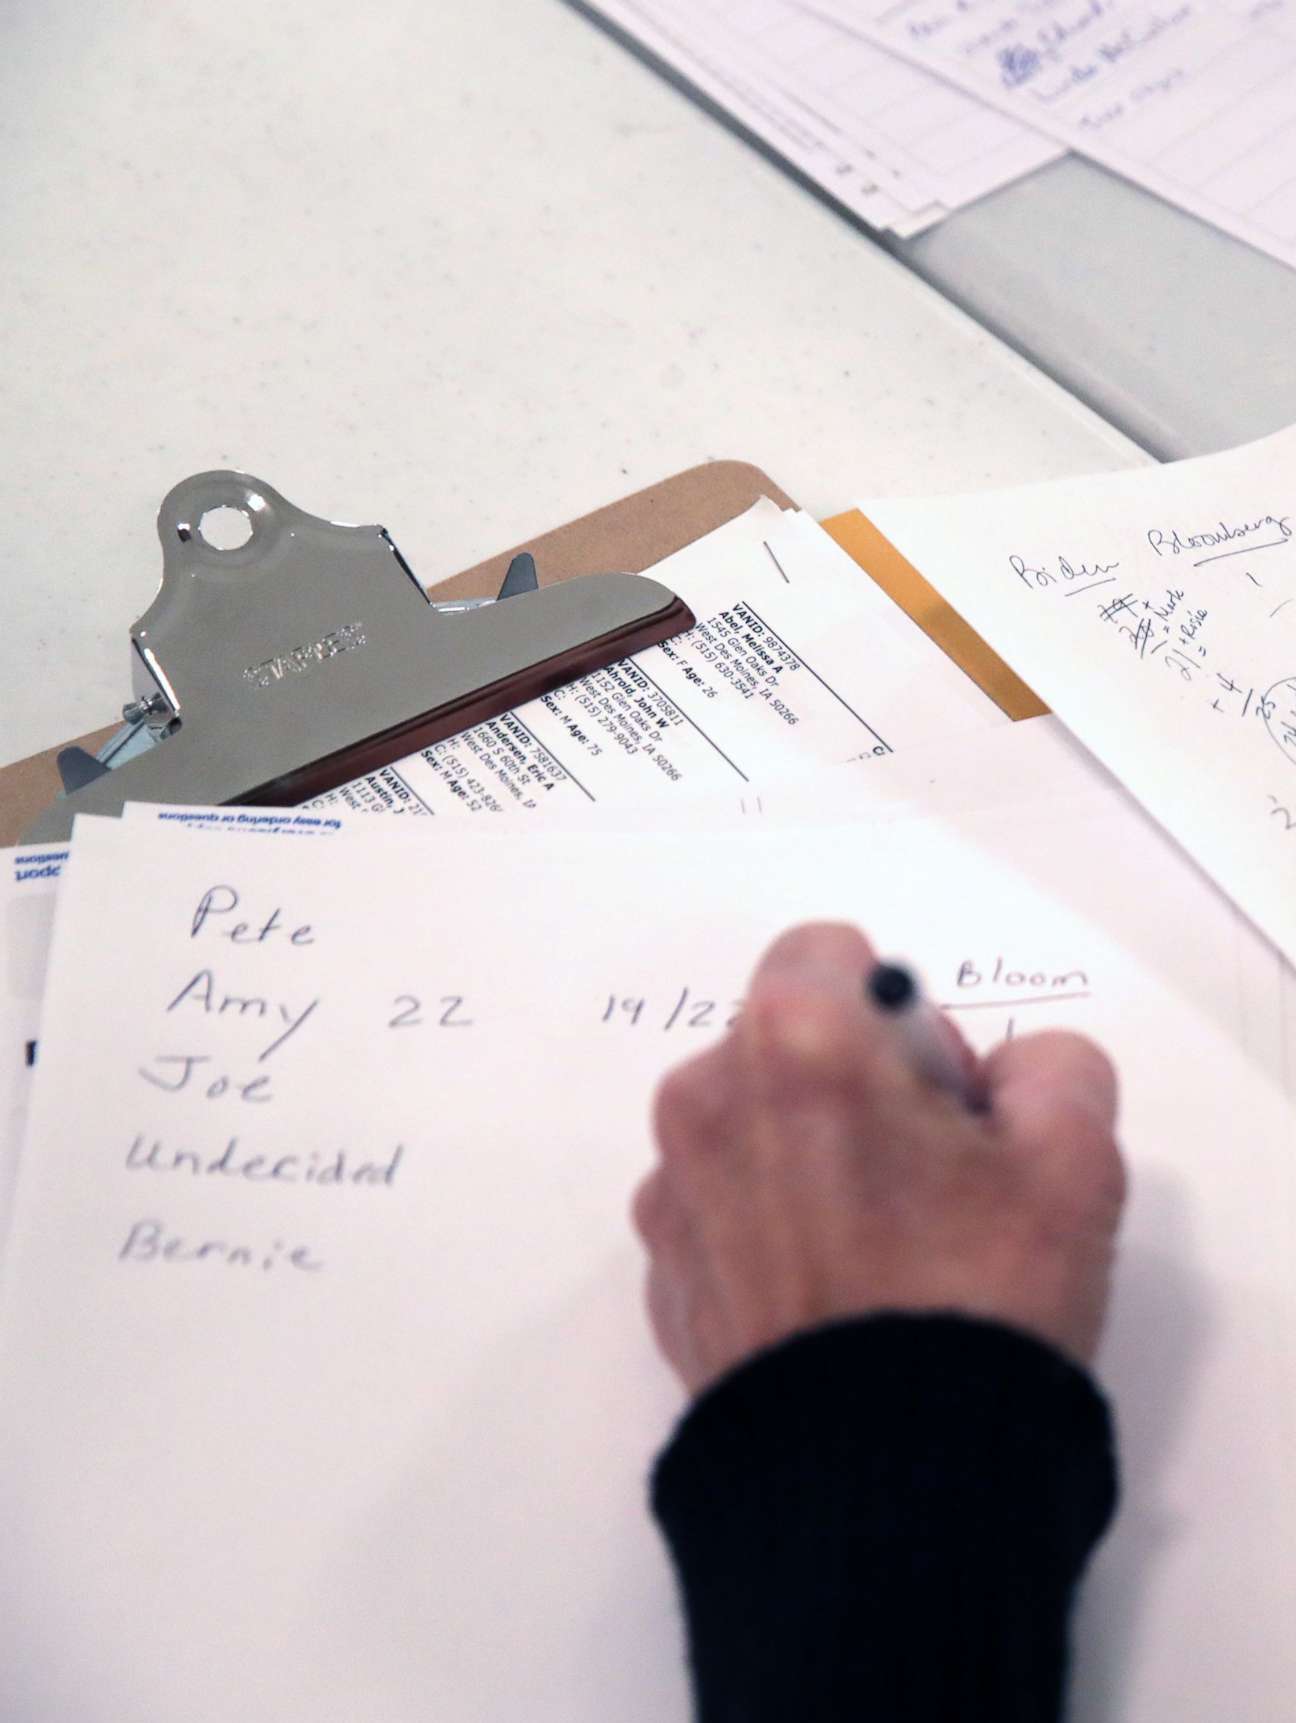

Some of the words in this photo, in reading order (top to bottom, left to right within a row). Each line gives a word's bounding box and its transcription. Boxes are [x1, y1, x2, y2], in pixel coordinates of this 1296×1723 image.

[1147, 515, 1293, 557] Bloomberg
[1009, 554, 1120, 589] Biden
[241, 621, 367, 689] STAPLES
[657, 641, 679, 661] Sex:
[677, 657, 688, 667] F
[707, 617, 729, 638] 1545
[727, 637, 748, 658] Glen
[745, 656, 767, 678] Oaks
[765, 675, 780, 688] Dr
[719, 611, 743, 634] Abel,
[742, 632, 775, 667] Melissa
[773, 664, 784, 674] A
[732, 603, 766, 638] VANID:
[763, 636, 801, 671] 9874378
[552, 689, 566, 700] C:
[604, 666, 635, 697] Ahrold,
[633, 696, 657, 719] John
[655, 717, 670, 729] W
[617, 659, 650, 692] VANID:
[647, 692, 685, 727] 3705811
[682, 665, 706, 687] Age:
[691, 640, 718, 664] (515)
[714, 661, 755, 700] 630-3541
[694, 622, 716, 643] West
[714, 642, 732, 660] Des
[731, 658, 759, 689] Moines,
[759, 687, 773, 701] IA
[769, 700, 799, 726] 50266
[702, 685, 719, 699] 26
[541, 695, 563, 716] Sex:
[560, 714, 572, 724] M
[567, 722, 590, 745] Age:
[587, 743, 603, 757] 75
[573, 694, 602, 718] (515)
[597, 716, 639, 756] 279-9043
[578, 677, 600, 699] West
[598, 698, 616, 715] Des
[614, 712, 643, 744] Moines,
[642, 743, 655, 756] IA
[652, 754, 682, 783] 50266
[591, 672, 615, 693] 1152
[611, 693, 632, 713] Glen
[629, 710, 654, 733] Oaks
[648, 730, 663, 743] Dr
[449, 737, 461, 749] H:
[460, 731, 483, 755] West
[480, 753, 497, 771] Des
[494, 769, 524, 801] Moines,
[473, 726, 497, 748] 1660
[492, 748, 504, 756] S
[499, 755, 521, 776] 60th
[517, 773, 531, 785] St
[486, 720, 528, 764] Andersen,
[527, 763, 547, 783] Eric
[543, 782, 556, 792] A
[500, 713, 533, 747] VANID:
[530, 747, 567, 782] 7581637
[339, 786, 361, 810] West
[366, 775, 395, 808] Austin,
[379, 768, 411, 804] VANID:
[421, 750, 443, 772] Sex:
[440, 770, 450, 781] M
[447, 778, 470, 800] Age:
[466, 799, 483, 812] 52
[433, 743, 445, 756] C:
[442, 754, 468, 778] (515)
[466, 778, 503, 812] 423-826
[323, 818, 342, 830] for
[190, 884, 316, 946] Pete
[956, 955, 1088, 988] Bloom
[167, 969, 320, 1062] Amy
[388, 995, 473, 1027] 22
[138, 1056, 274, 1102] Joe
[118, 1217, 324, 1273] Bernie
